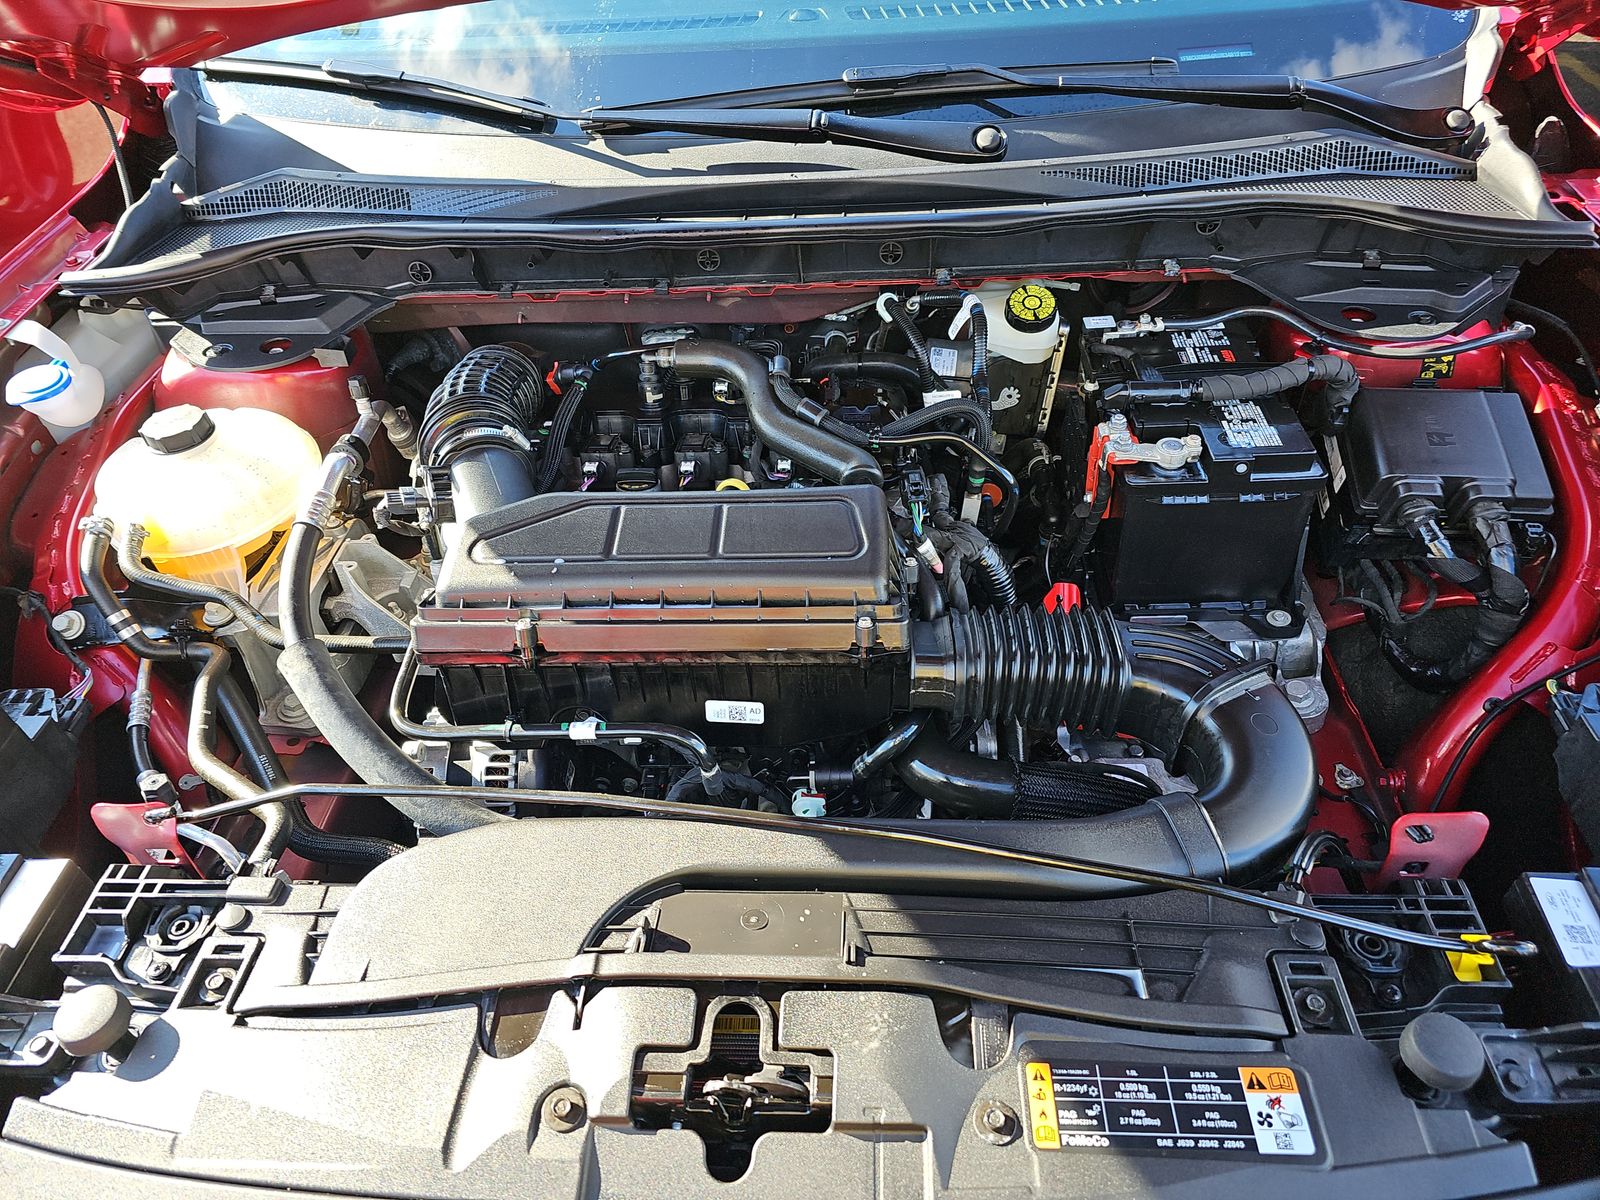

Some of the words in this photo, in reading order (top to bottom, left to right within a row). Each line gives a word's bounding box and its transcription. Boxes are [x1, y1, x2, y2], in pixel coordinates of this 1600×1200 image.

[1053, 1083, 1088, 1094] R-1234yf
[1138, 1083, 1149, 1093] kg
[1210, 1084, 1221, 1094] kg
[1058, 1109, 1078, 1118] PAG
[1131, 1109, 1146, 1117] PAG
[1204, 1111, 1220, 1119] PAG
[1061, 1134, 1110, 1147] FoMoCo
[1156, 1138, 1174, 1147] SAE
